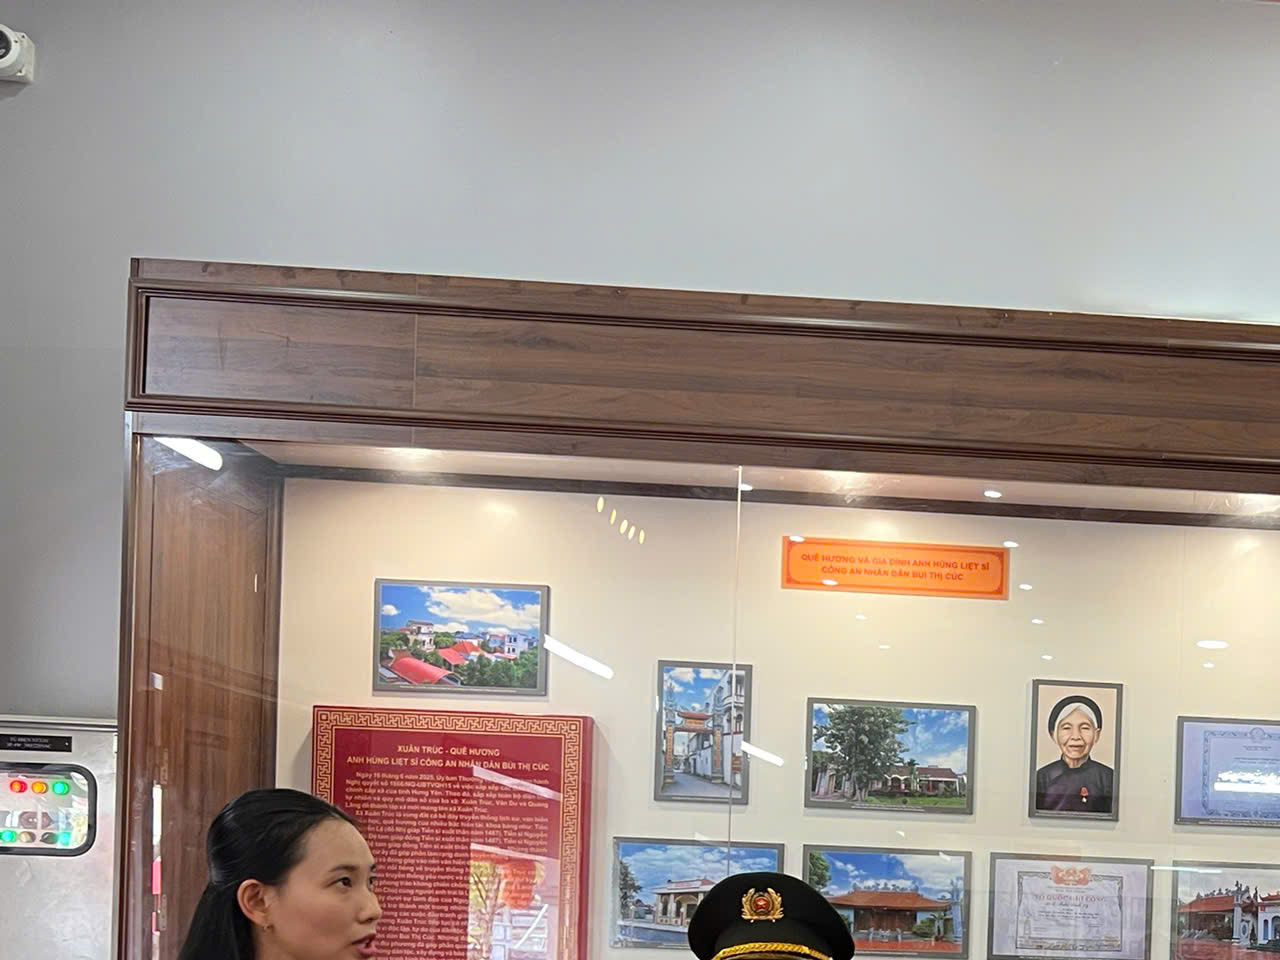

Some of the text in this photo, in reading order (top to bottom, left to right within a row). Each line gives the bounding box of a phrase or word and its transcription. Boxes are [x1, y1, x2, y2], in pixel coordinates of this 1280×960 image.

[800, 552, 818, 561] QUÊ
[857, 555, 870, 564] VÀ
[872, 556, 886, 565] GIA
[912, 558, 930, 567] ANH
[933, 559, 957, 568] HÙNG
[960, 561, 978, 570] LIỆT
[981, 561, 989, 570] SĨ
[822, 564, 847, 574] CÔNG
[848, 567, 861, 575] AN
[864, 567, 888, 576] NHÂN
[891, 568, 909, 577] DÂN
[929, 571, 942, 580] THỊ
[944, 571, 963, 580] CÚC
[397, 743, 419, 753] XUÂN
[422, 744, 443, 754] TRÚC
[449, 745, 467, 755] QUÊ
[469, 747, 500, 756] HƯƠNG
[366, 755, 389, 764] HÙNG
[391, 758, 408, 766] LIỆT
[410, 757, 418, 765] SĨ
[420, 757, 443, 766] CÔNG
[483, 760, 500, 768] DÂN
[517, 762, 530, 771] THỊ
[532, 762, 549, 770] CÚC
